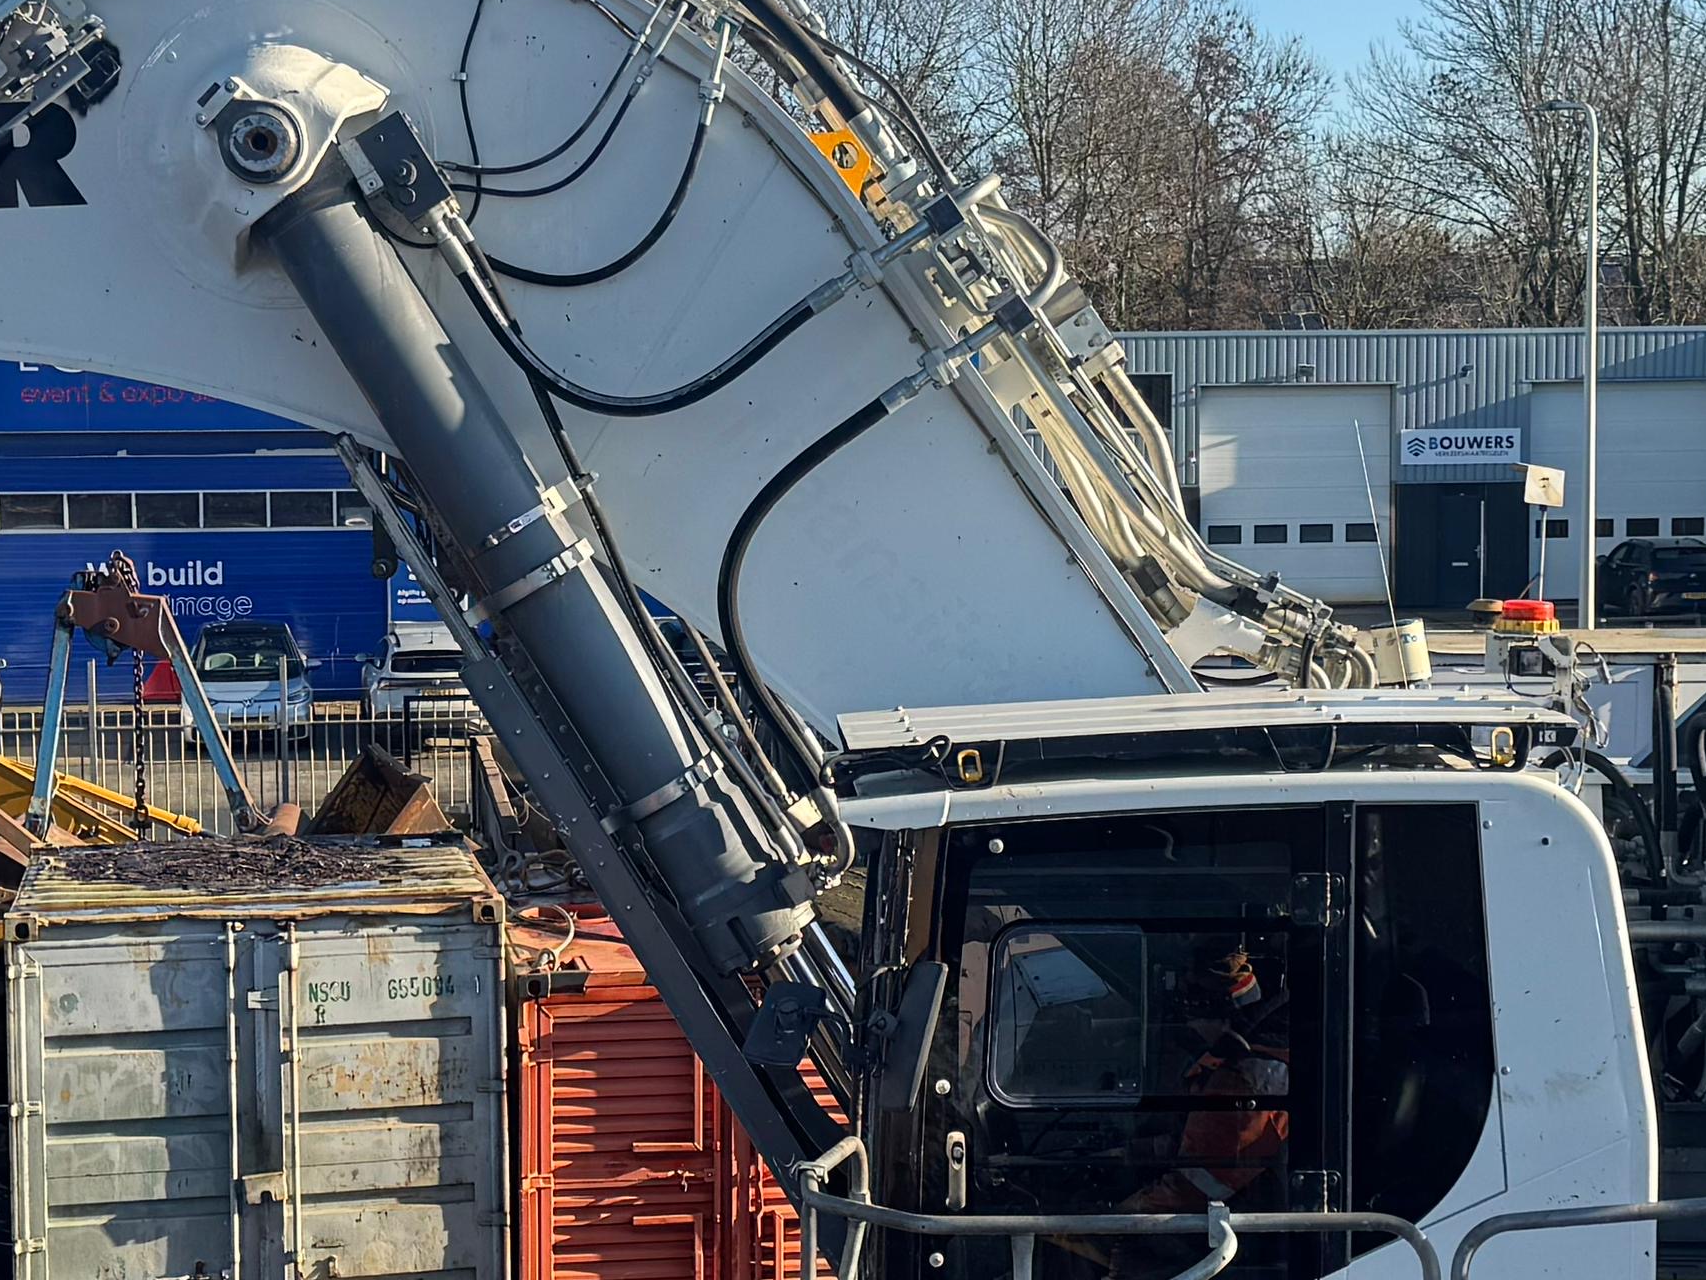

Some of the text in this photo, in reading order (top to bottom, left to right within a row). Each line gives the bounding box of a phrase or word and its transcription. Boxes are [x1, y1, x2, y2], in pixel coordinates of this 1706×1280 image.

[21, 383, 91, 404] event
[99, 382, 117, 403] &
[1428, 435, 1515, 450] BOUWERS
[147, 560, 223, 586] build
